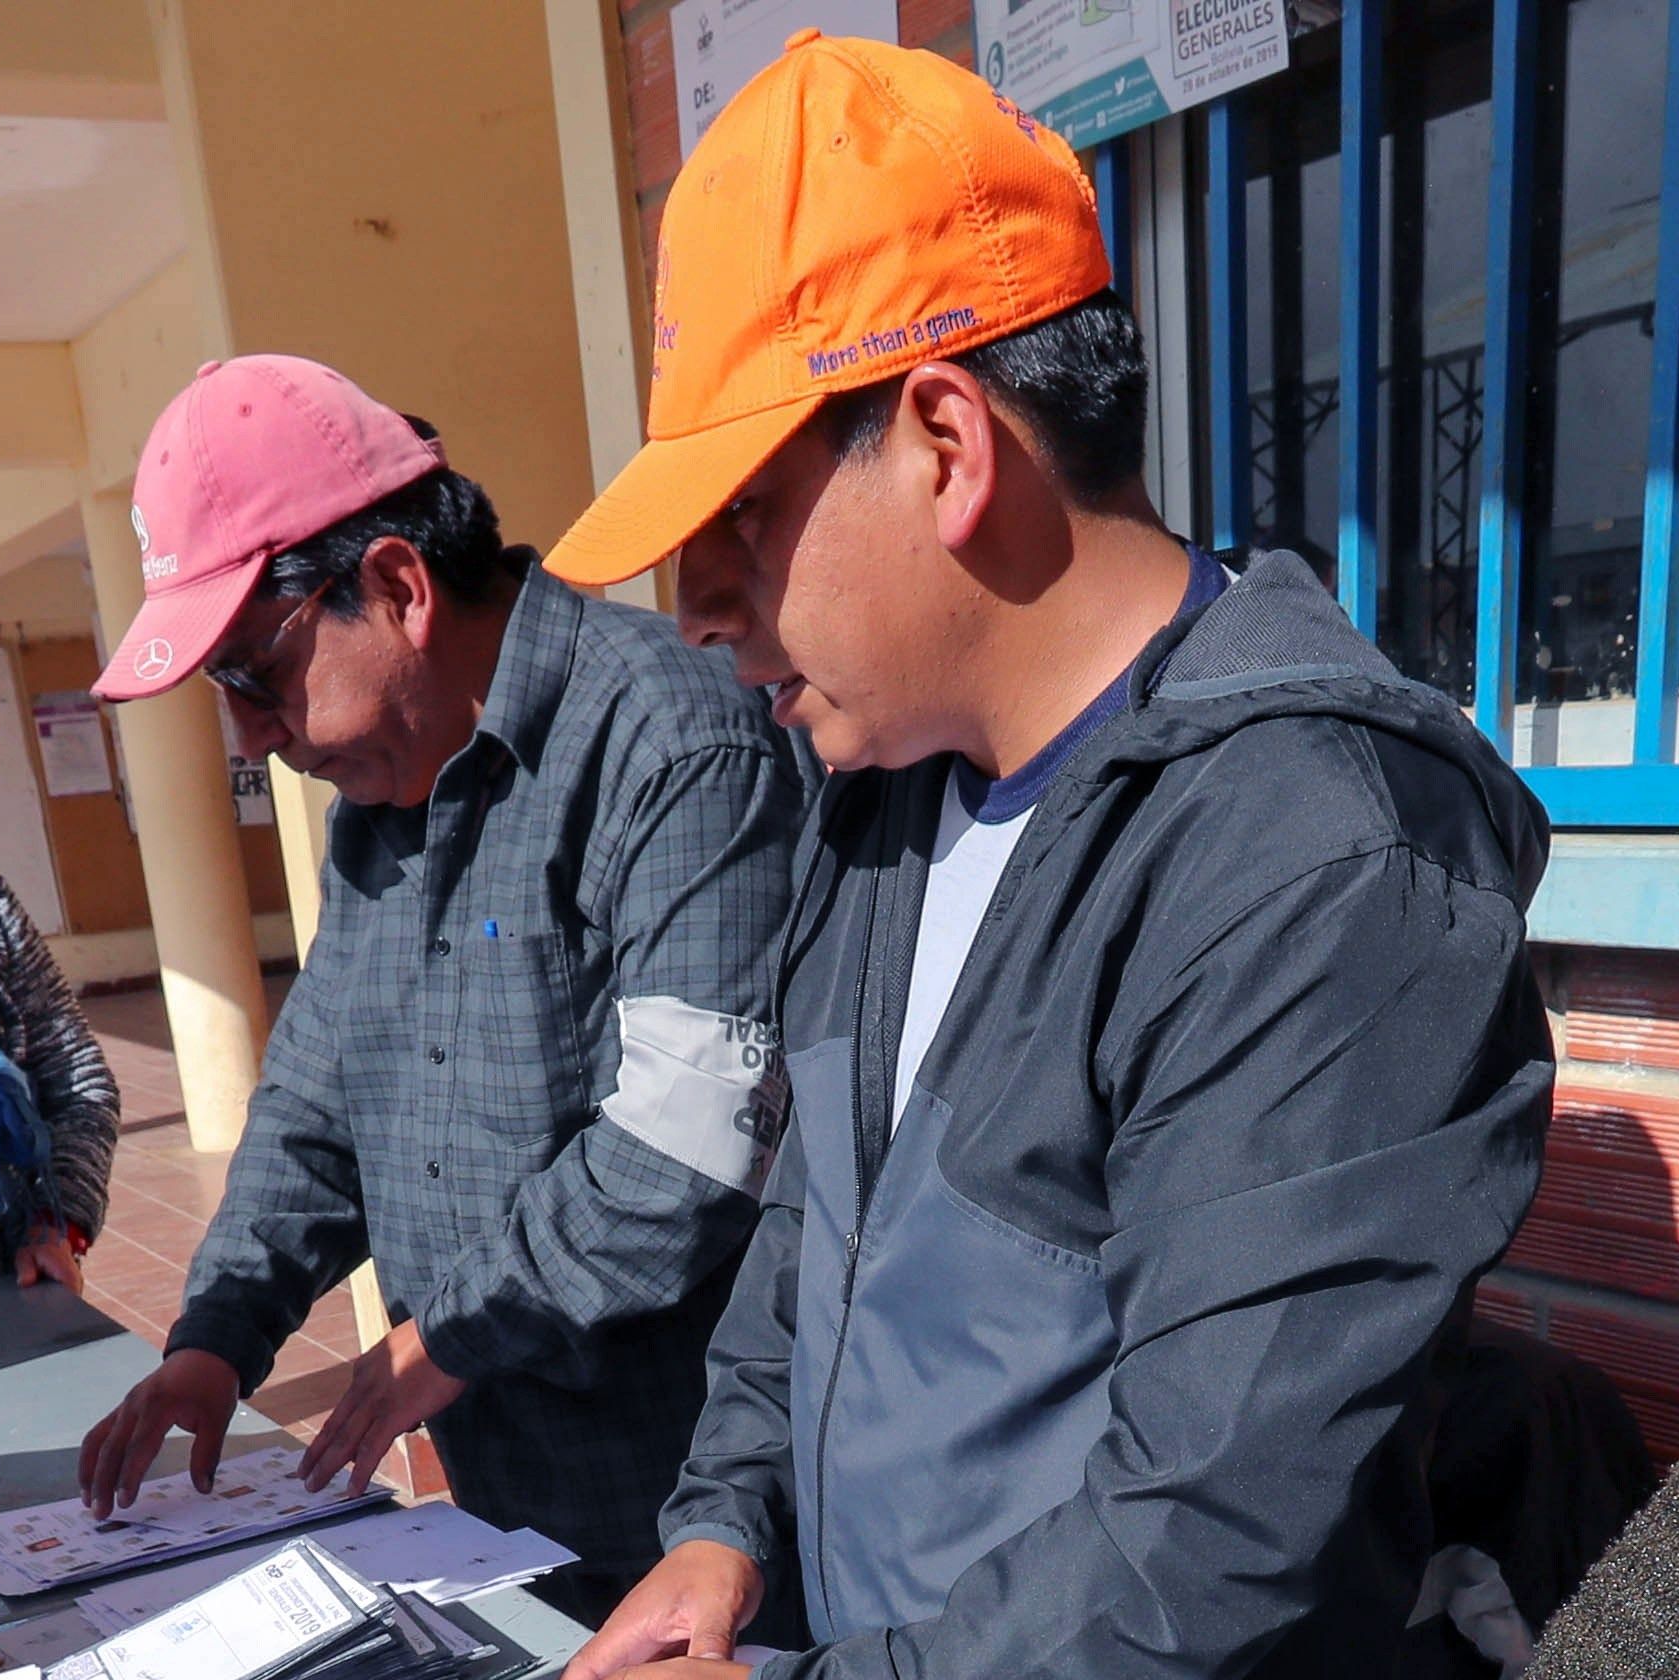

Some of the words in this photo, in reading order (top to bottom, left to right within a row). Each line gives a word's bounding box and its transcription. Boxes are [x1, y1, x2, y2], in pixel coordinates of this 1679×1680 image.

[1178, 1, 1275, 61] GENERALES
[987, 40, 1004, 89] 6
[693, 80, 718, 110] DE:
[807, 346, 859, 378] More
[862, 327, 908, 360] than
[912, 321, 924, 342] a
[925, 306, 984, 348] game.
[290, 1607, 322, 1636] 2019
